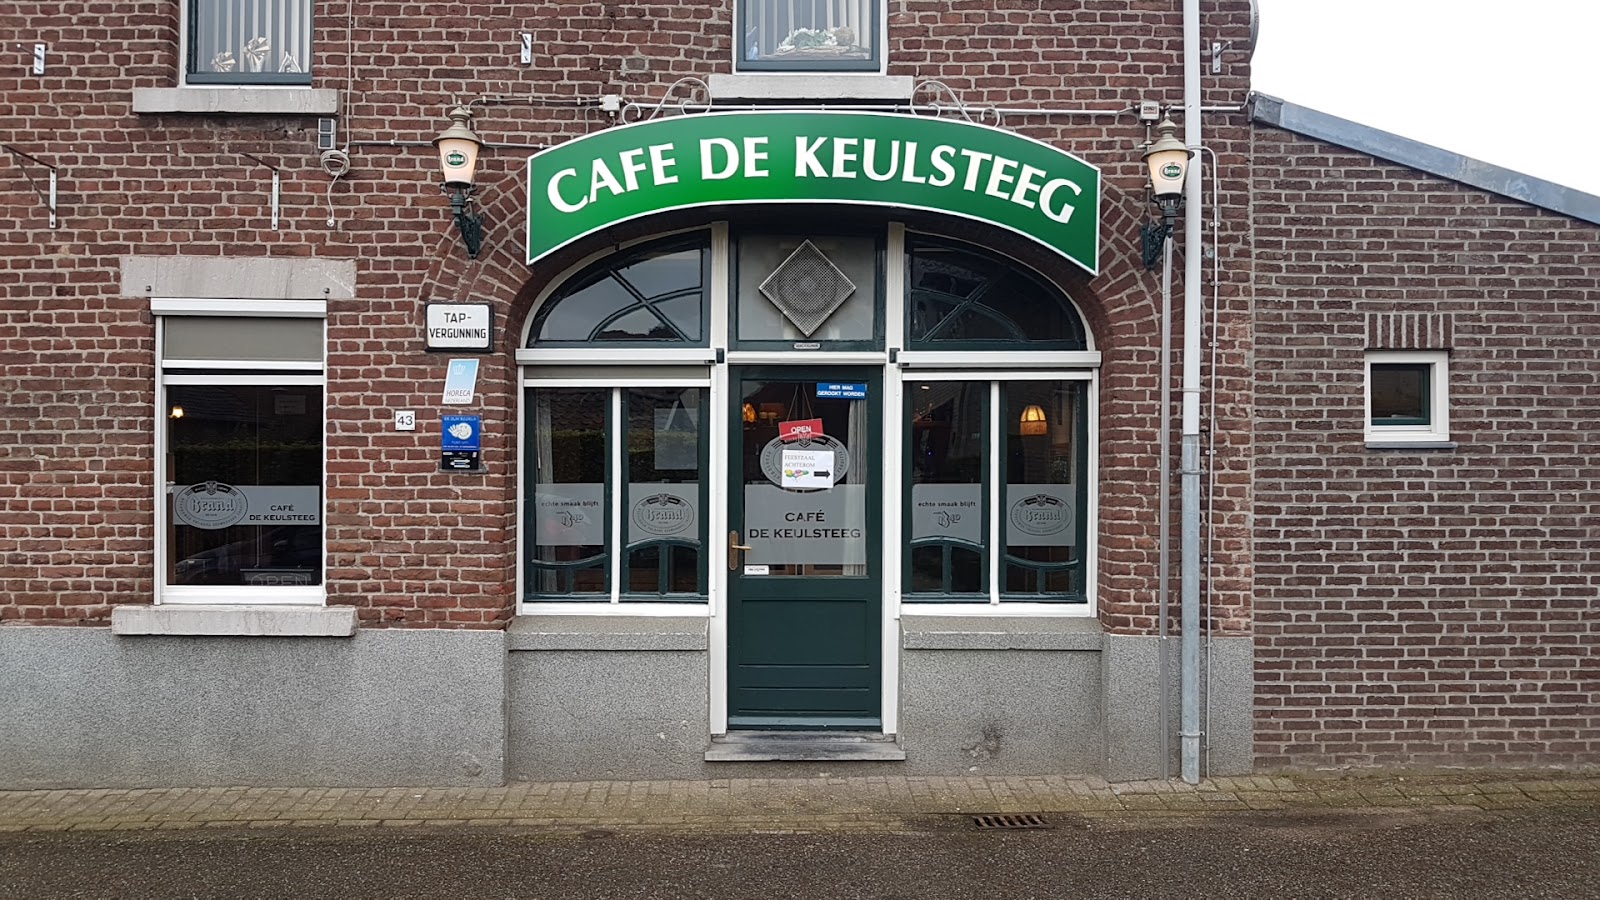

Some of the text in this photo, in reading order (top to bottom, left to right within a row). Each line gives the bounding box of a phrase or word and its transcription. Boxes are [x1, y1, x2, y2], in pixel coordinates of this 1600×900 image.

[547, 135, 1083, 224] CAFE DE KEULSTEEG
[444, 312, 472, 324] TAP-
[429, 327, 487, 339] VERGUNNING
[446, 389, 471, 397] HORECA
[397, 415, 413, 426] 43
[790, 425, 812, 434] OPEN
[190, 498, 235, 514] Brand
[270, 504, 294, 512] CAFÉ
[582, 500, 599, 508] blijft
[959, 500, 977, 508] blijft
[645, 508, 683, 522] Brand
[785, 509, 825, 522] CAFÉ
[749, 528, 861, 538] DE KEULSTEEG
